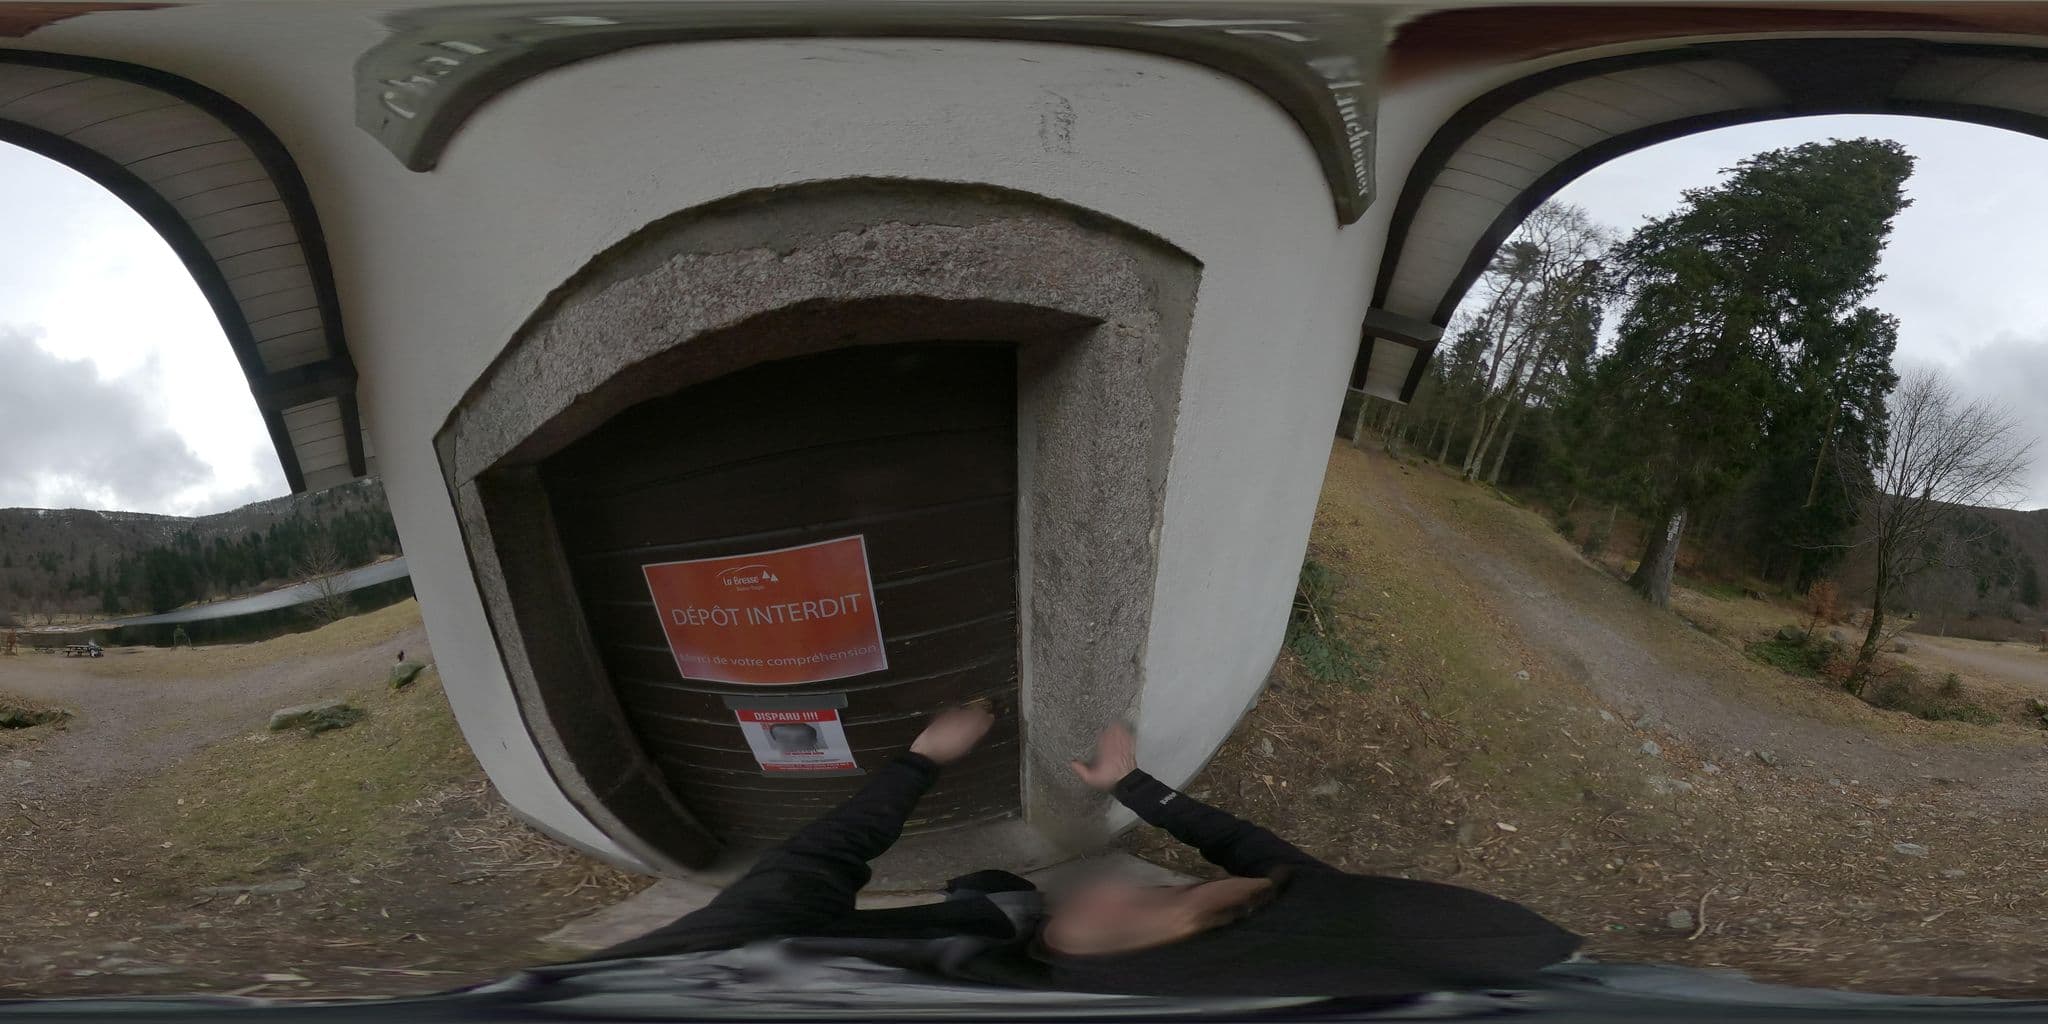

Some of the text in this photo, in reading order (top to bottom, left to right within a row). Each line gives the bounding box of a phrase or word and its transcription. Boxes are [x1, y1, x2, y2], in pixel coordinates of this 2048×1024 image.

[672, 594, 862, 626] DÉPÔT INTERDIT
[713, 656, 728, 665] de
[731, 655, 764, 667] votre
[767, 645, 878, 669] compréhension
[753, 712, 800, 721] DISPARU
